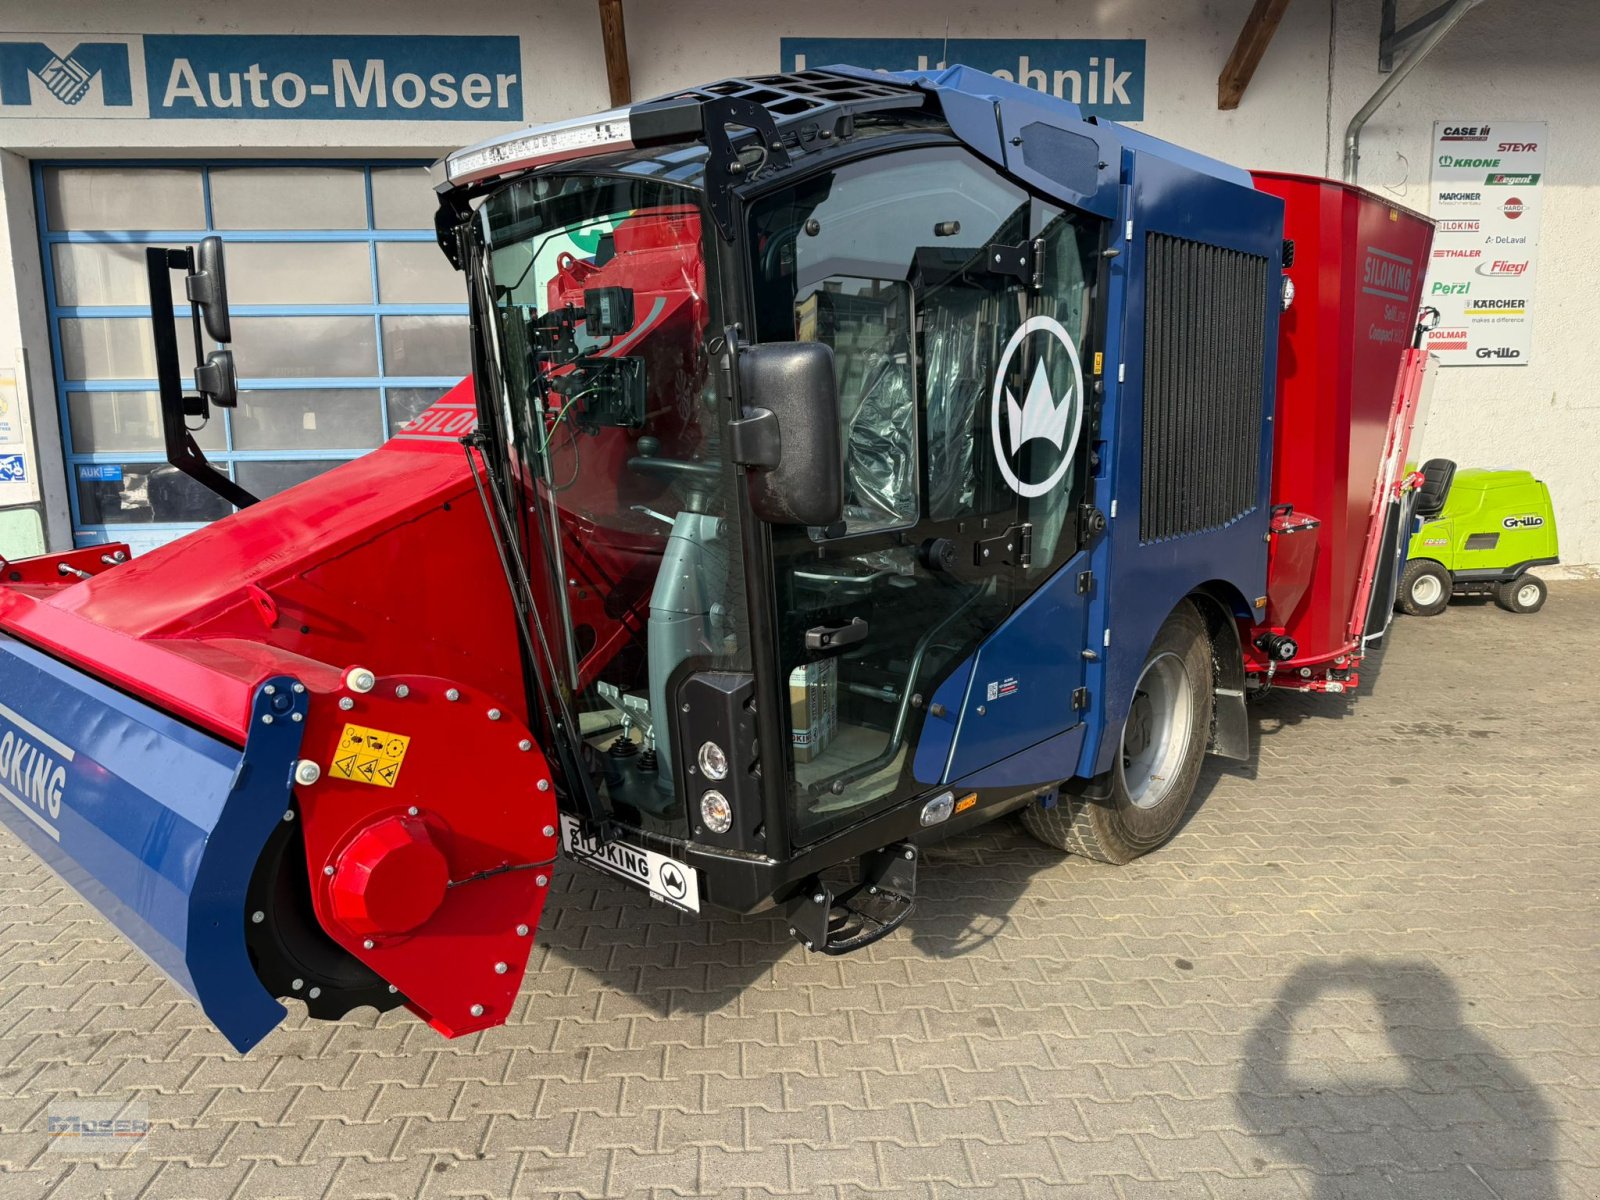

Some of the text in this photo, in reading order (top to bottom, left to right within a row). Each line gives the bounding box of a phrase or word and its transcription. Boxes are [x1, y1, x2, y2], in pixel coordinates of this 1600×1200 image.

[162, 58, 517, 110] Auto-Moser
[1443, 127, 1478, 136] CASE
[1497, 143, 1538, 153] STEYR
[1453, 159, 1501, 168] KRONE
[1493, 174, 1533, 186] Regent
[1441, 222, 1480, 230] ILOKING
[1495, 236, 1526, 244] DeLaval
[1445, 250, 1482, 258] THALER
[1490, 260, 1529, 275] Fliegl
[1363, 256, 1412, 293] SILOKING
[1431, 281, 1471, 295] Perzl
[1428, 331, 1468, 339] DOLMAR
[1475, 347, 1520, 359] Grillo
[1503, 516, 1544, 528] Grillo
